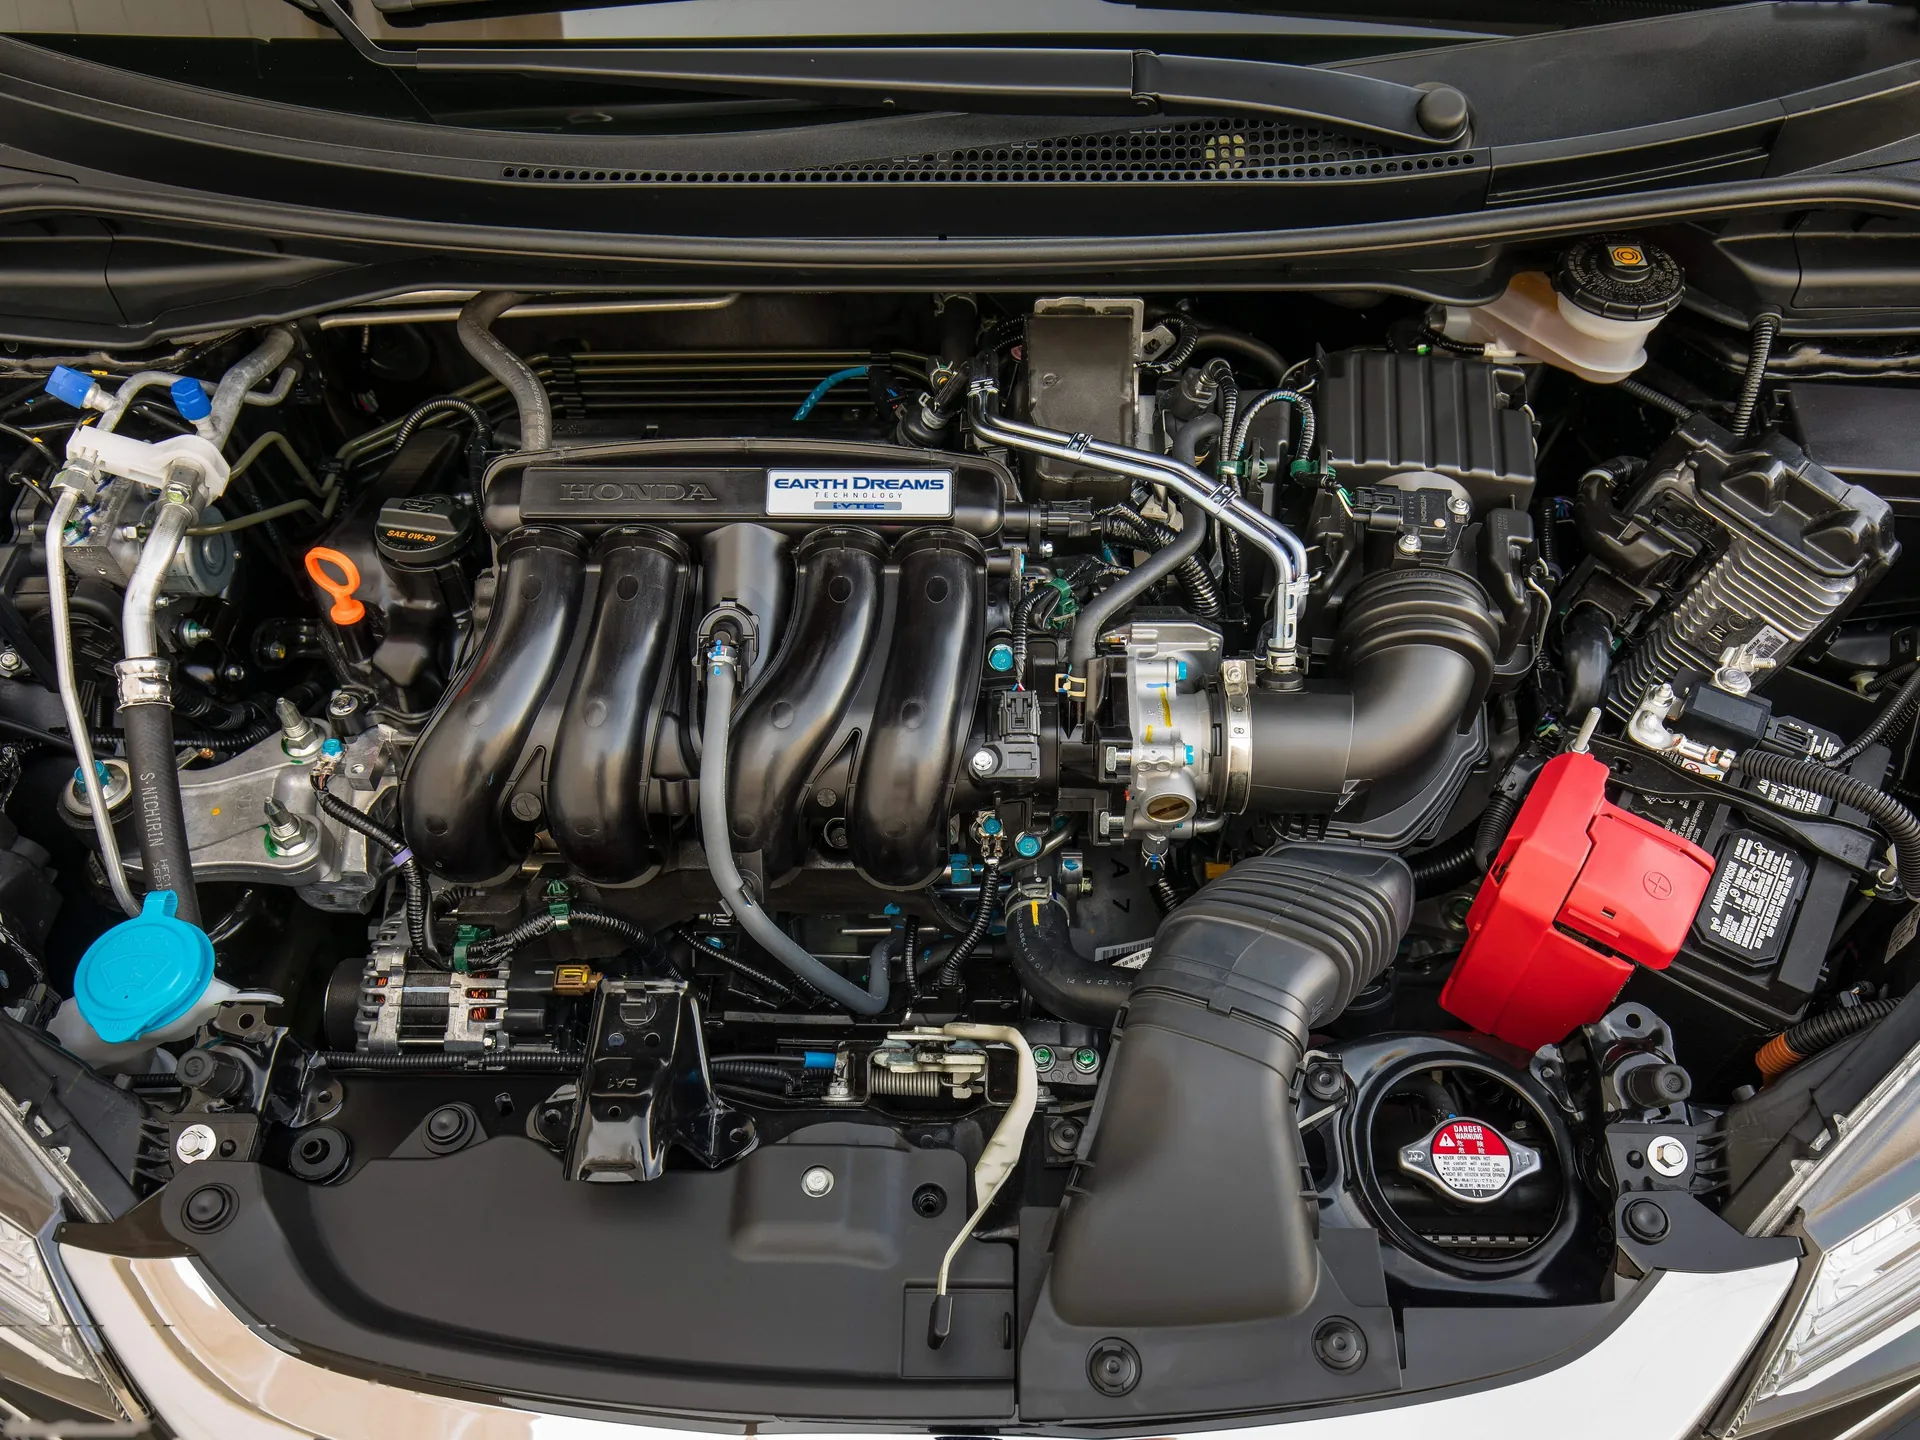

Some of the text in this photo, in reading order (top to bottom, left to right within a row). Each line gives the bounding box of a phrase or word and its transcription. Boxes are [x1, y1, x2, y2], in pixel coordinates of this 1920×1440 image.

[774, 477, 944, 490] EARTH DREAMS
[559, 483, 718, 501] HONDA
[386, 530, 407, 539] SAE
[408, 532, 437, 542] 0W-20
[1713, 860, 1737, 905] DANGER/POISON
[1453, 1125, 1483, 1133] DANGER
[1472, 1189, 1483, 1197] 1.1
